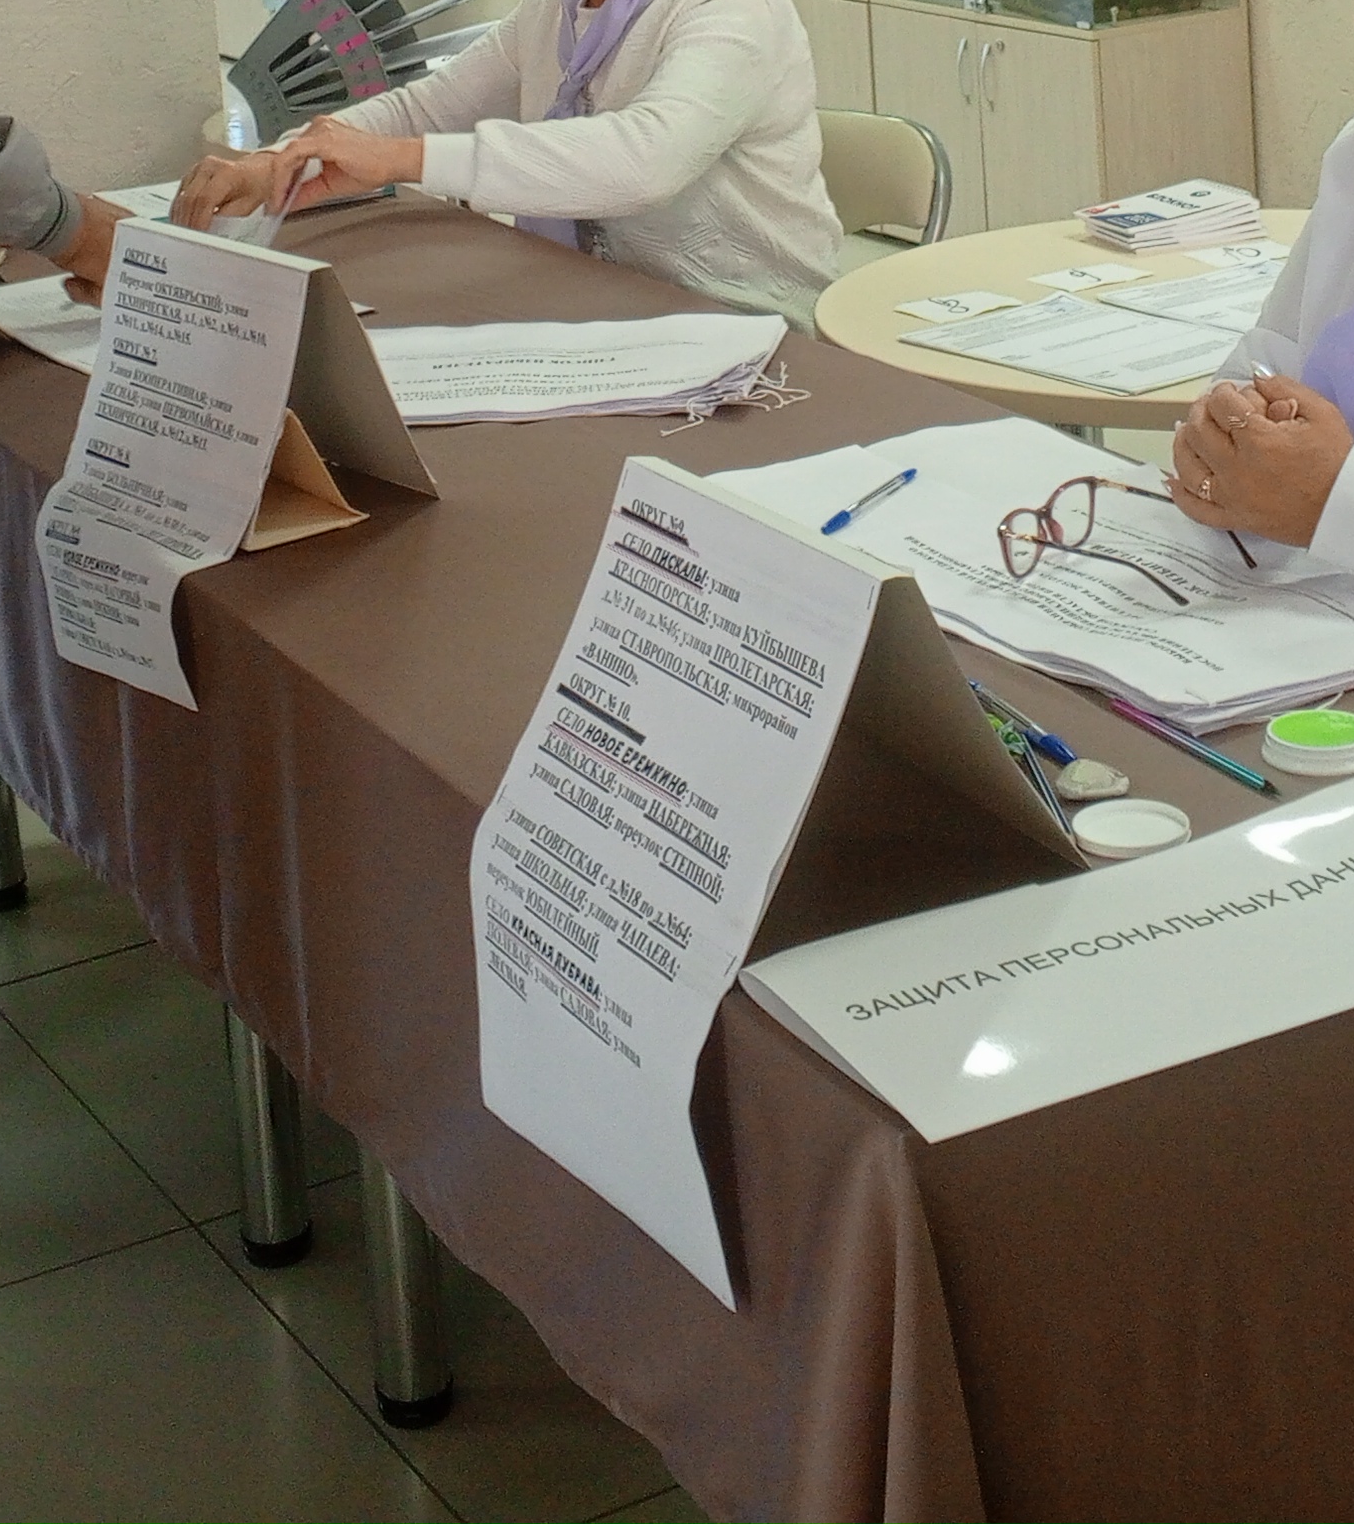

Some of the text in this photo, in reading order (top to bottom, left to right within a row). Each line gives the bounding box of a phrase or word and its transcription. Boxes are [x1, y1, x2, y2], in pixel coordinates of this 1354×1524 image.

[631, 499, 669, 525] ОКРУГ
[622, 532, 652, 558] СЕЛО
[711, 579, 741, 603] улица
[613, 558, 826, 683] КРАСНОГОРСКАЯ; улица КУЙБЫШЕВА
[678, 631, 713, 656] улица
[569, 672, 606, 702] ОКРУГ
[589, 616, 799, 740] улица СТАВРОПОЛЬСКАЯ; микрорайон
[556, 707, 585, 732] СЕЛО
[583, 723, 625, 756] НОВОЕ
[686, 791, 719, 820] улица
[613, 782, 647, 811] улица
[505, 808, 537, 835] улица
[535, 824, 603, 879] СОВЕТСКАЯ
[529, 762, 561, 790] улица
[613, 818, 664, 856] переулок
[491, 833, 522, 860] улица
[584, 902, 619, 931] улица
[485, 894, 511, 922] СЕЛО
[511, 913, 555, 962] КРАСНАЯ
[603, 997, 633, 1028] улица
[845, 967, 1002, 1022] ЗАЩИТА
[997, 888, 1291, 979] ПЕРСОНАЛЬНЫХ
[613, 1035, 642, 1069] улица
